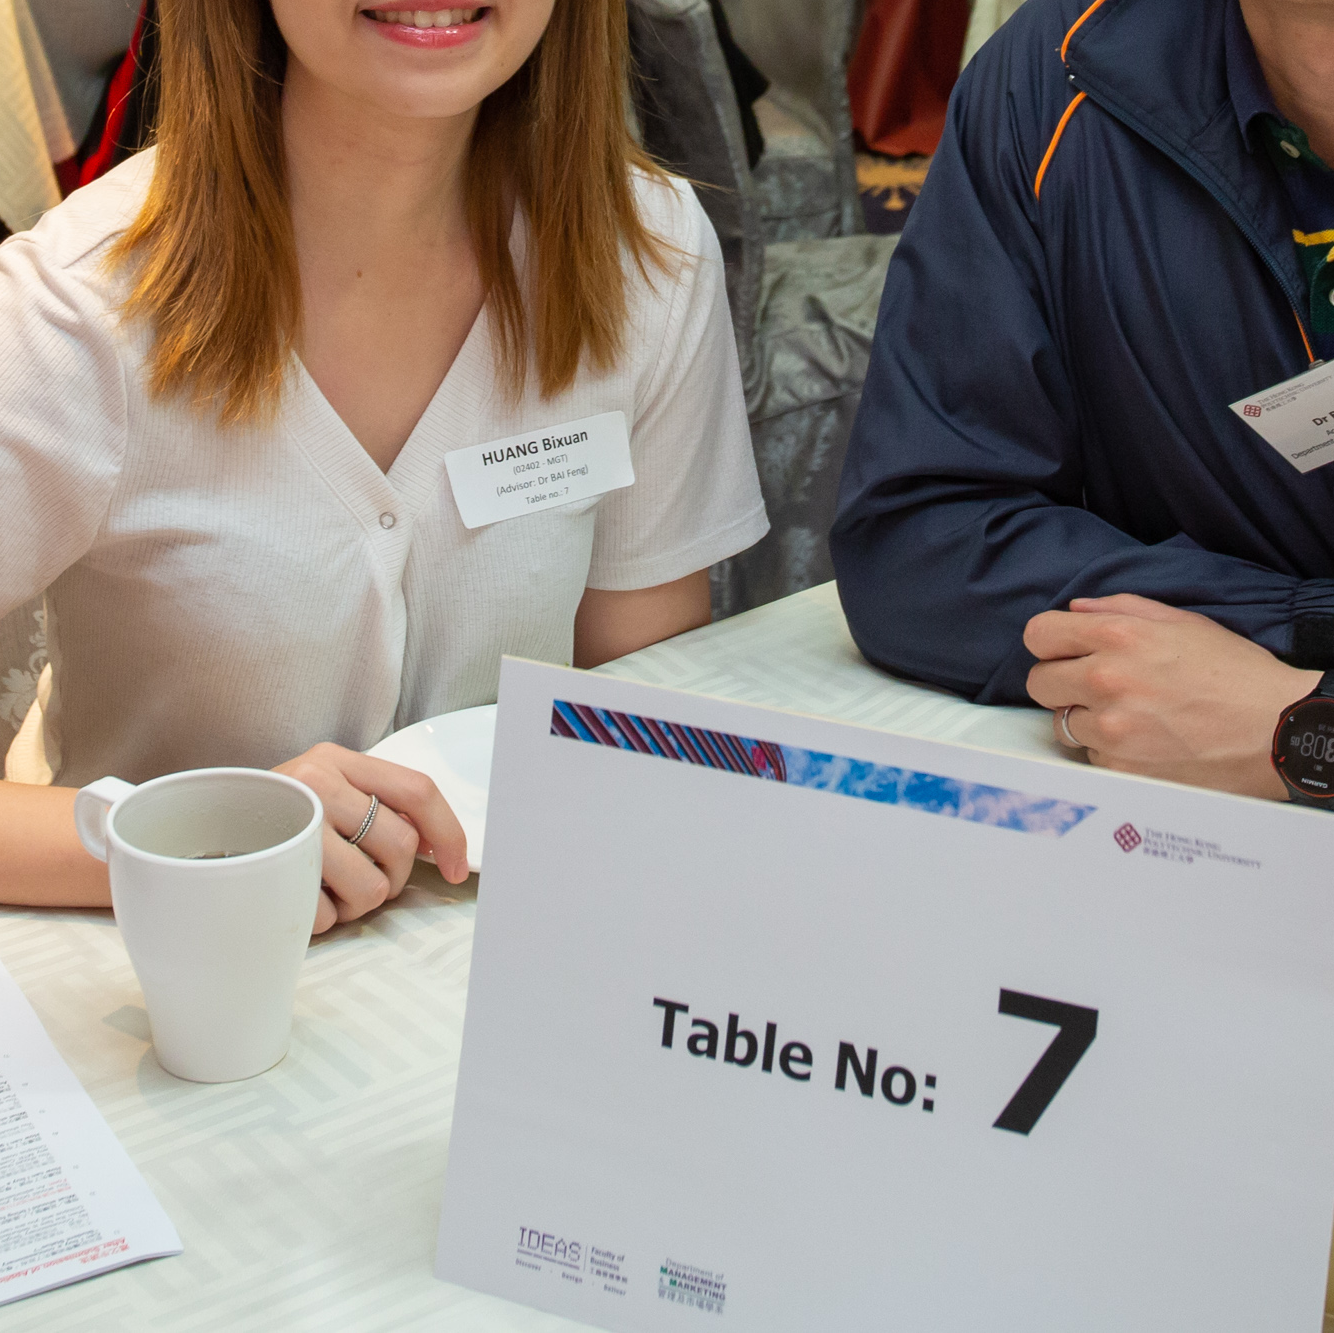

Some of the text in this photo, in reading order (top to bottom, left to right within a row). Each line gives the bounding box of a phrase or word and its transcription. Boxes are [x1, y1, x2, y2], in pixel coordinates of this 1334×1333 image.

[1312, 415, 1328, 426] Dr
[482, 431, 588, 466] HUANG Bixuan
[513, 461, 540, 475] (02402
[547, 454, 569, 466] MGT)
[496, 464, 589, 497] (Advisor: Dr BAI Feng)
[526, 492, 547, 504] Table
[1301, 777, 1328, 789] GARMIN
[653, 987, 1099, 1136] Table No: 7
[517, 1226, 582, 1263] IDEAS
[591, 1246, 616, 1262] Faculty
[617, 1254, 625, 1263] of
[590, 1256, 620, 1272] Business
[665, 1257, 714, 1279] Department
[660, 1265, 727, 1292] MANAGEMENT
[669, 1278, 726, 1301] MARKETING
